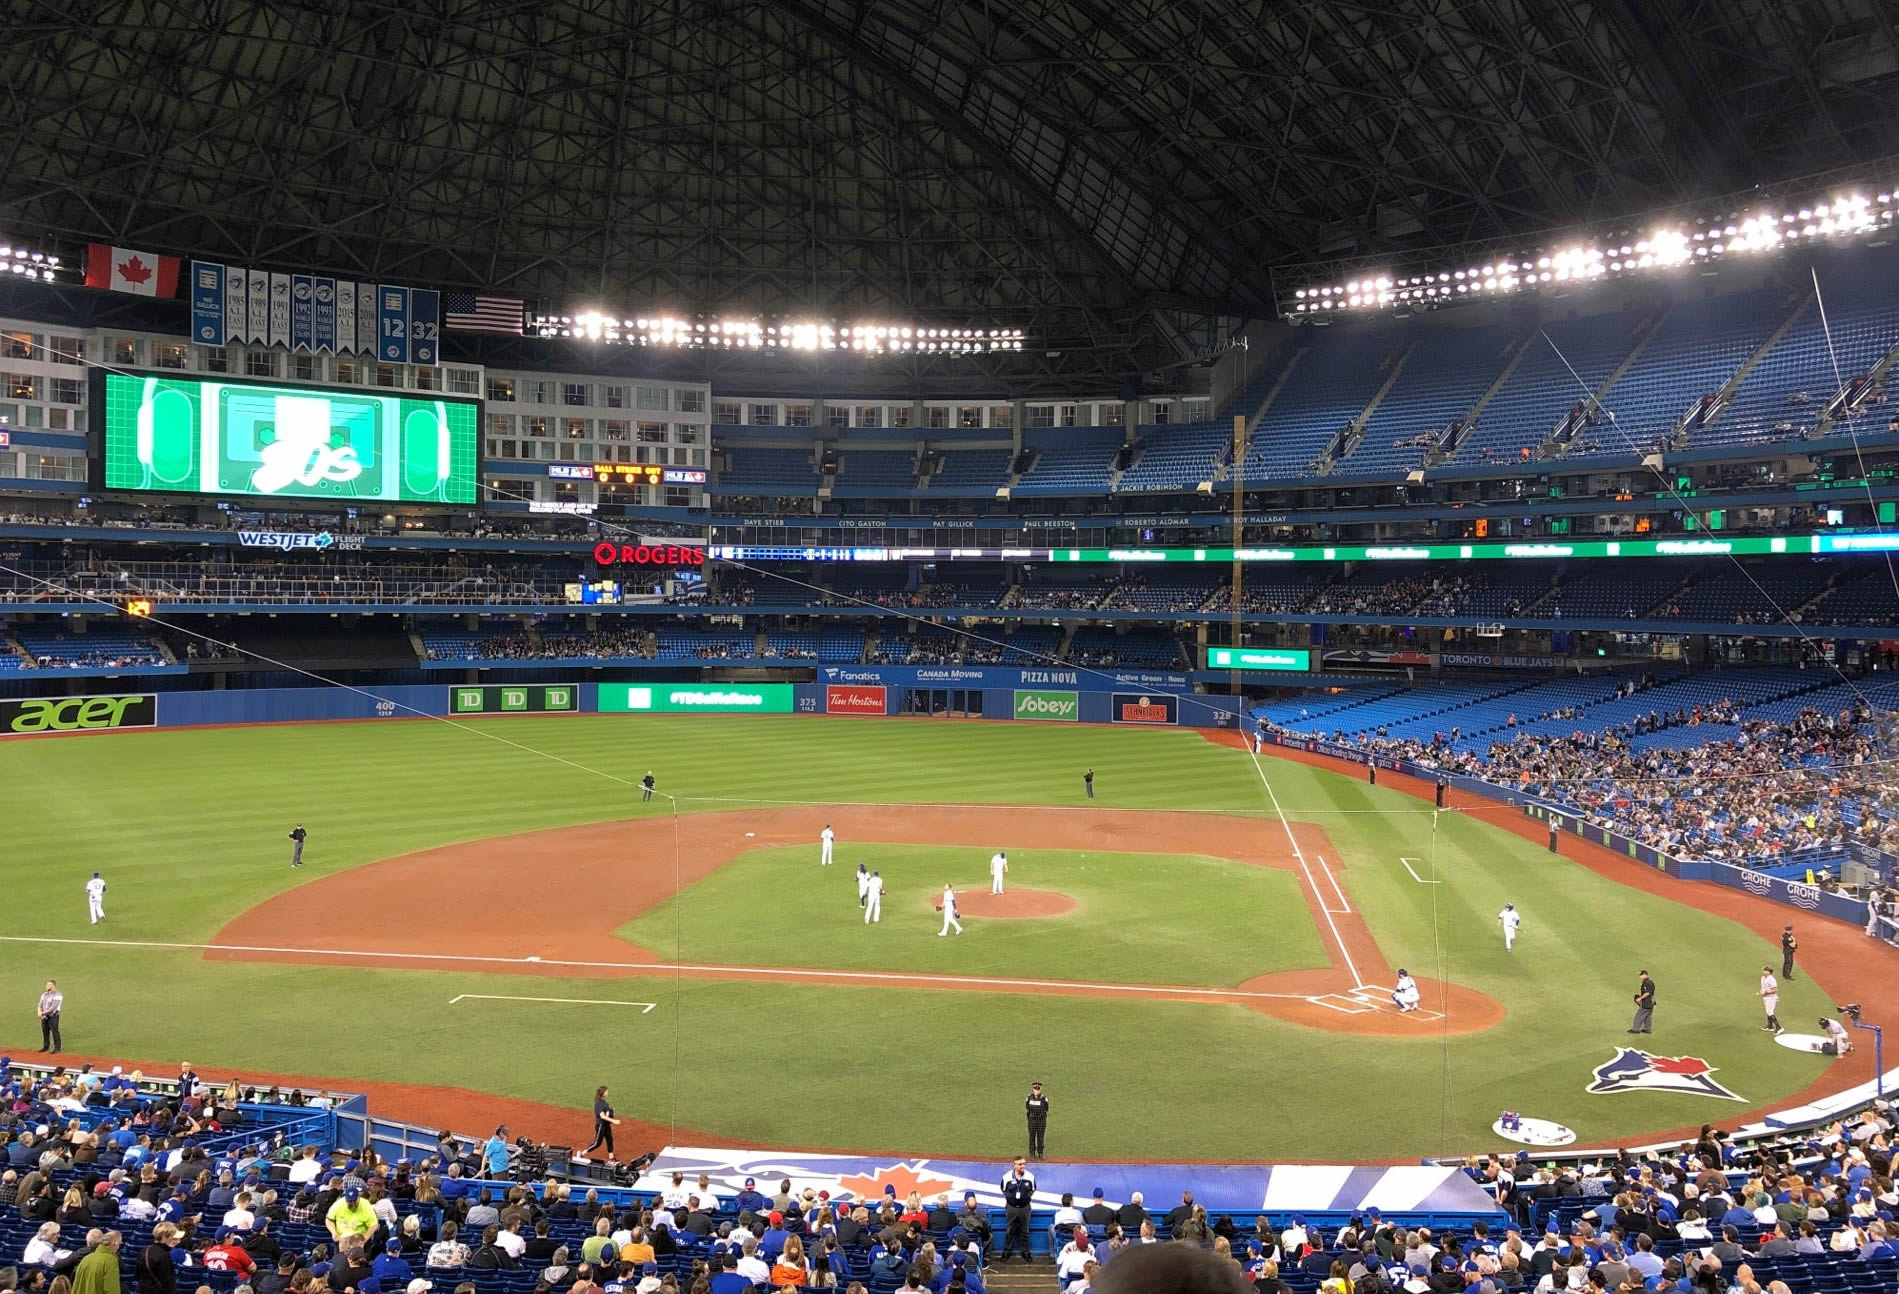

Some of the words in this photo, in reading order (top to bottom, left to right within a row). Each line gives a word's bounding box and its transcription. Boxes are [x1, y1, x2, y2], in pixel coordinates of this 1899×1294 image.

[295, 303, 310, 314] 1992
[317, 305, 332, 316] 1993
[383, 318, 404, 337] 12
[411, 321, 438, 340] 32
[595, 464, 614, 473] BALL
[616, 466, 642, 475] STRIKE
[645, 467, 661, 475] OUT
[240, 533, 313, 549] WESTJET
[335, 535, 366, 543] FLIGHT
[621, 545, 705, 565] ROGERS
[1443, 654, 1491, 664] TORONTO
[1503, 656, 1526, 666] BLUE
[1529, 657, 1553, 667] JAYS
[840, 670, 880, 681] Fanatics
[917, 670, 948, 678] CANADA
[951, 670, 983, 678] MOVING
[1021, 671, 1048, 683] PIZZA
[1051, 672, 1077, 685] NOVA
[460, 692, 481, 706] TD
[504, 692, 525, 705] TD
[548, 691, 568, 705] TD
[800, 698, 816, 706] 375
[830, 694, 847, 706] Tim
[848, 694, 883, 707] Hortons
[376, 702, 395, 710] 400
[1018, 695, 1074, 716] Sobeys
[11, 696, 143, 732] acer
[1212, 711, 1231, 720] 328
[1741, 871, 1772, 888] GROHE
[1786, 884, 1821, 901] GROHE
